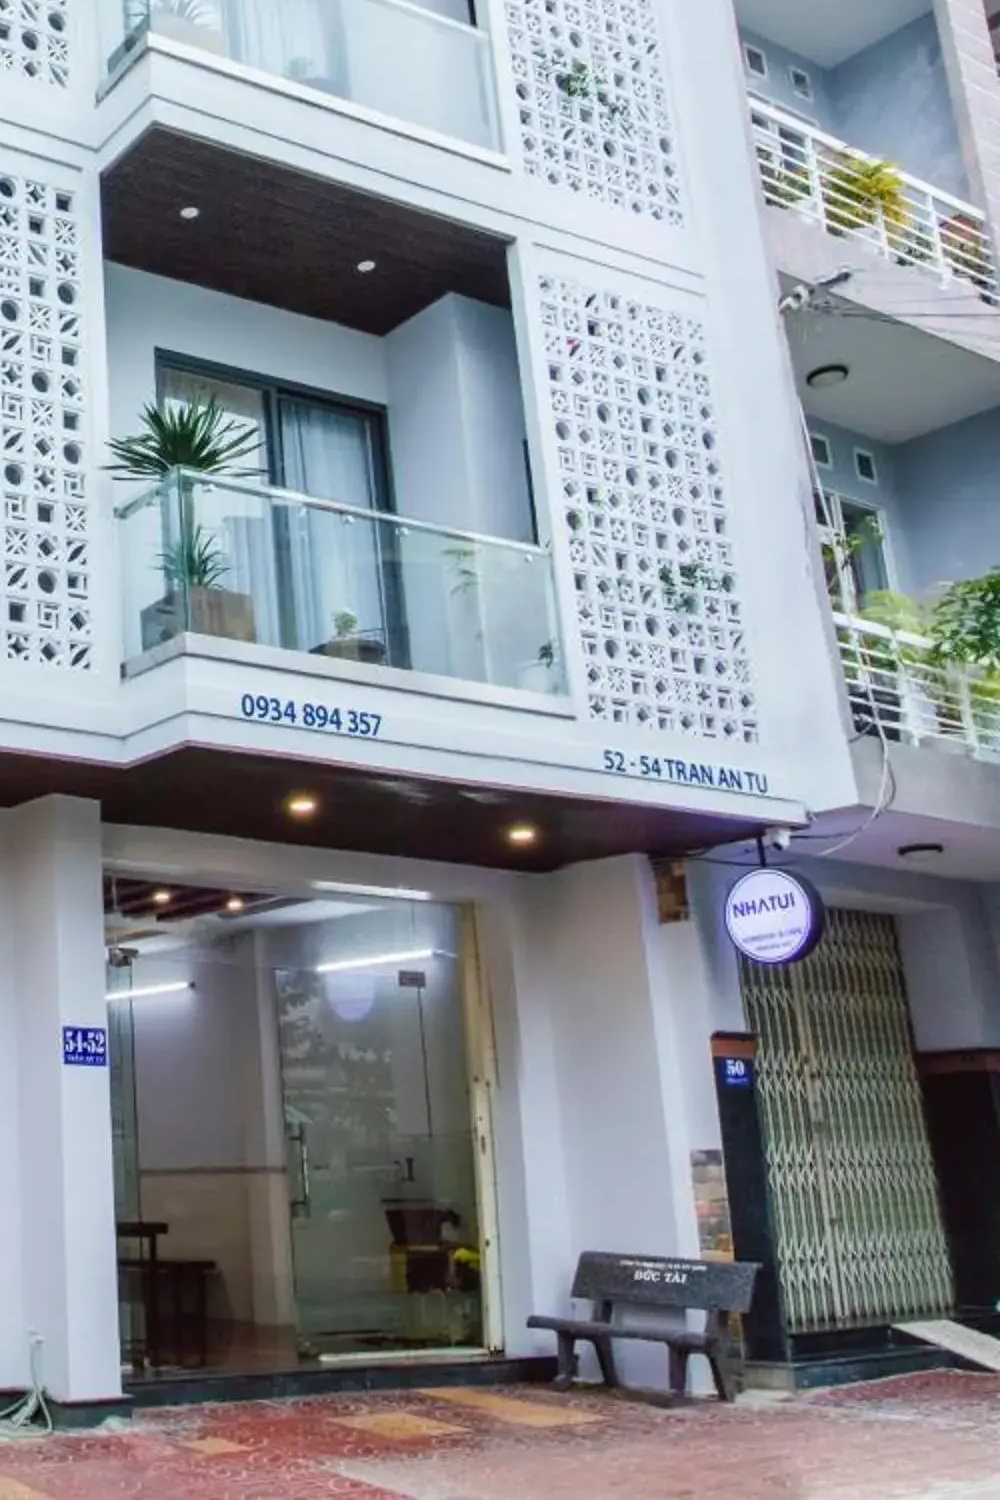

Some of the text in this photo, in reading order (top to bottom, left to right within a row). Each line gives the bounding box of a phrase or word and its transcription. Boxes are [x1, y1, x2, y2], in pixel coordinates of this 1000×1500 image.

[241, 693, 382, 736] 0934 894 357
[603, 750, 626, 772] 52
[639, 756, 661, 777] 54
[664, 759, 714, 786] TRAN
[718, 767, 743, 790] AN
[744, 772, 769, 794] TU
[726, 1059, 745, 1076] 50
